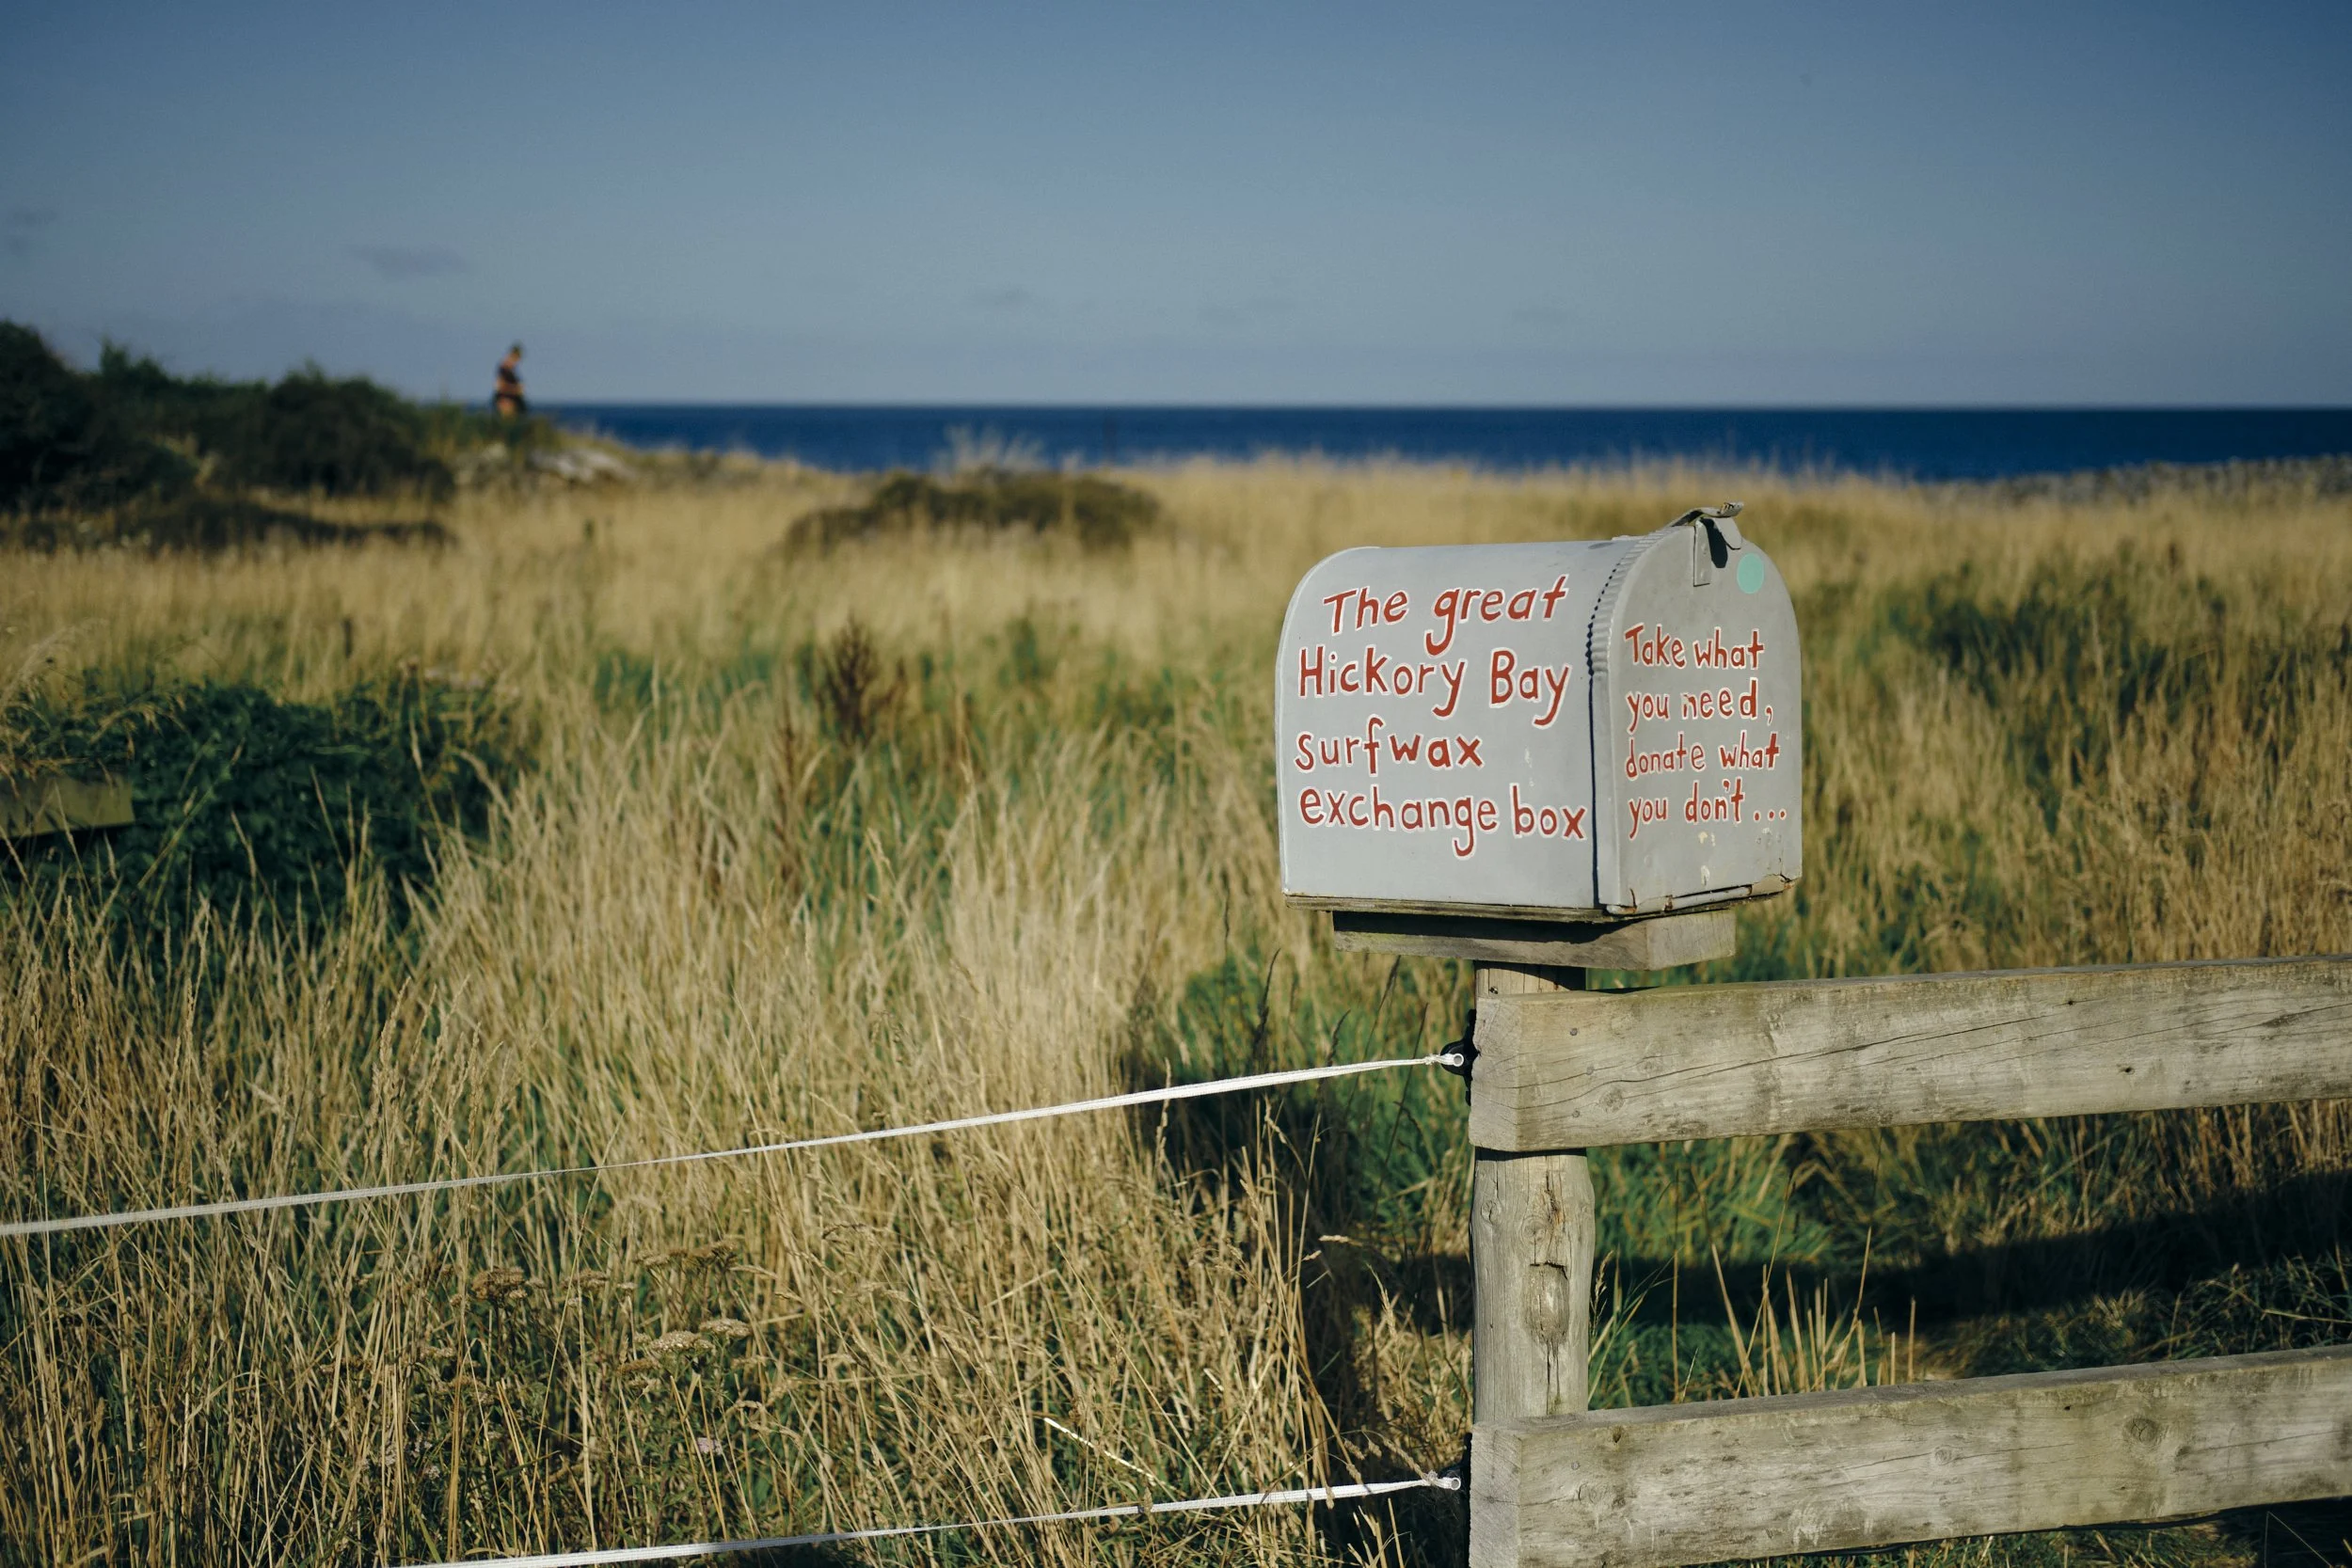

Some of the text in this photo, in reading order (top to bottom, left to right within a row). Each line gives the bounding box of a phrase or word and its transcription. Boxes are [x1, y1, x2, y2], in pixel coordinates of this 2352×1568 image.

[1323, 575, 1569, 657] The great
[1625, 624, 1764, 669] Take what
[1298, 645, 1570, 726] Hickory Bay
[1627, 678, 1773, 733] you need,
[1626, 732, 1780, 779] donate what
[1299, 784, 1586, 857] exchange box
[1629, 798, 1667, 839] you
